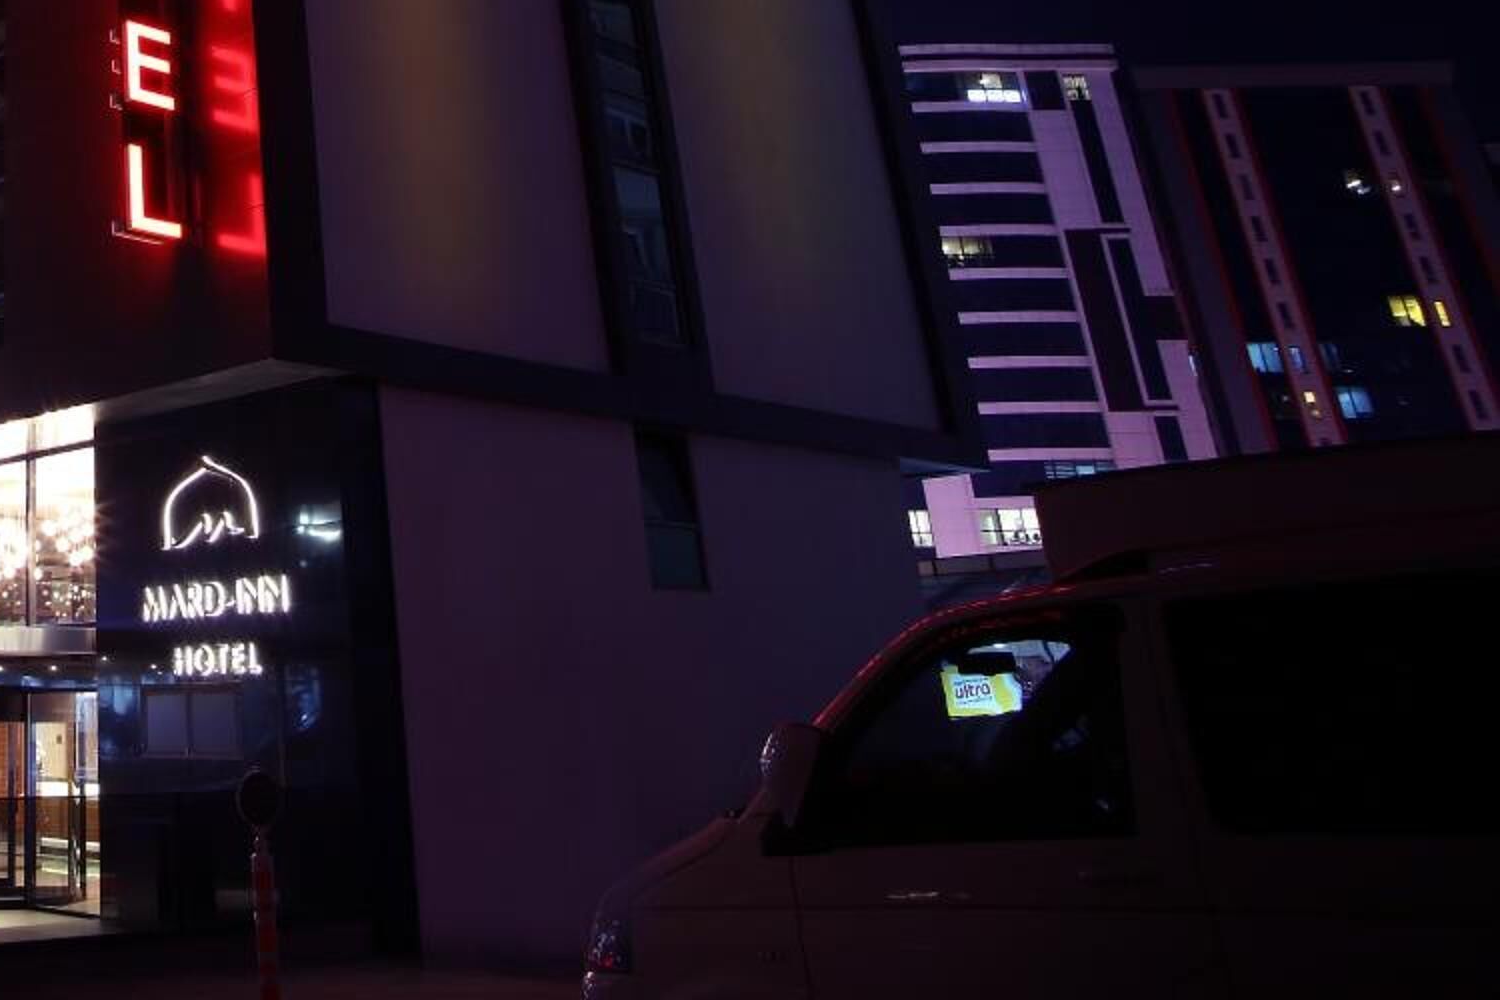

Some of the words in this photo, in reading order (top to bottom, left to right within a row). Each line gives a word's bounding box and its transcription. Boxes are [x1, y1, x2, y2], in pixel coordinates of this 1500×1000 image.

[143, 574, 291, 622] MARD-INN
[172, 642, 263, 677] HOTEL
[955, 683, 991, 699] ultra
